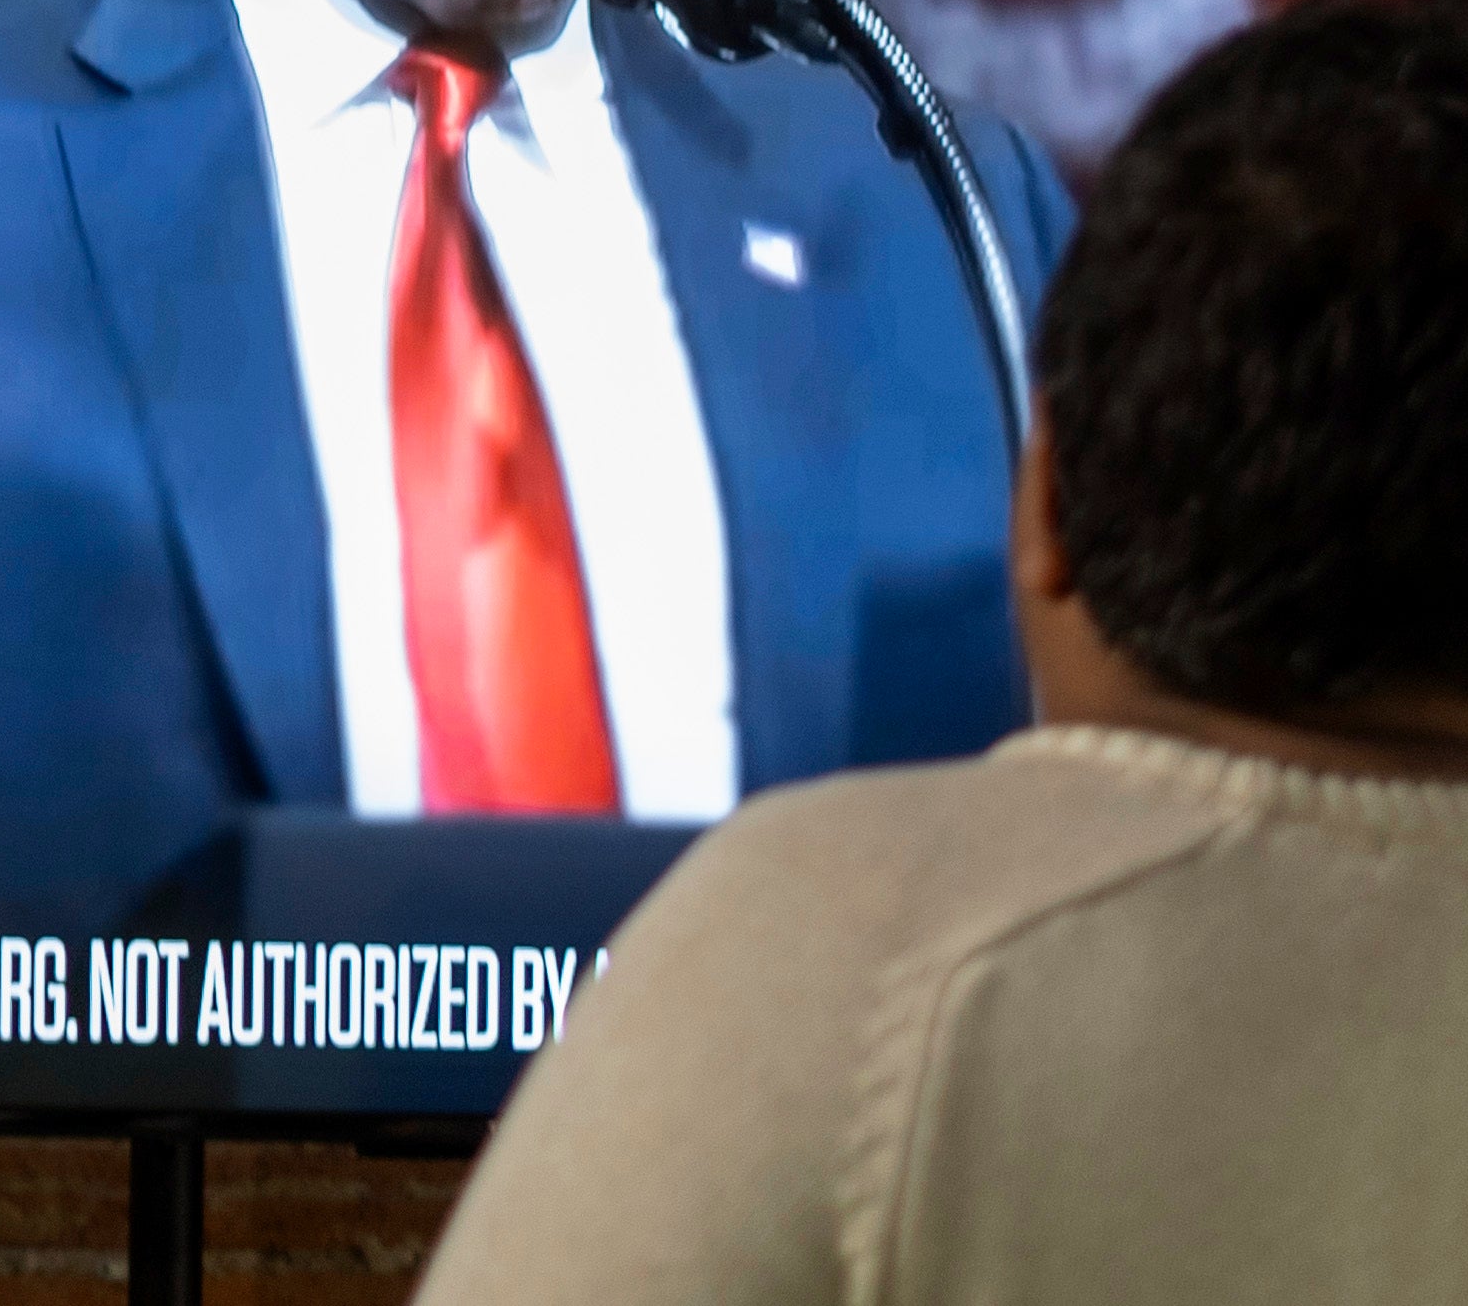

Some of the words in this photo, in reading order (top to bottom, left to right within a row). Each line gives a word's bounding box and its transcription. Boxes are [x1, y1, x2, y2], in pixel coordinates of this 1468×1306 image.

[88, 938, 190, 1046] NOT
[195, 939, 500, 1050] AUTHORIZED
[511, 945, 577, 1052] BY
